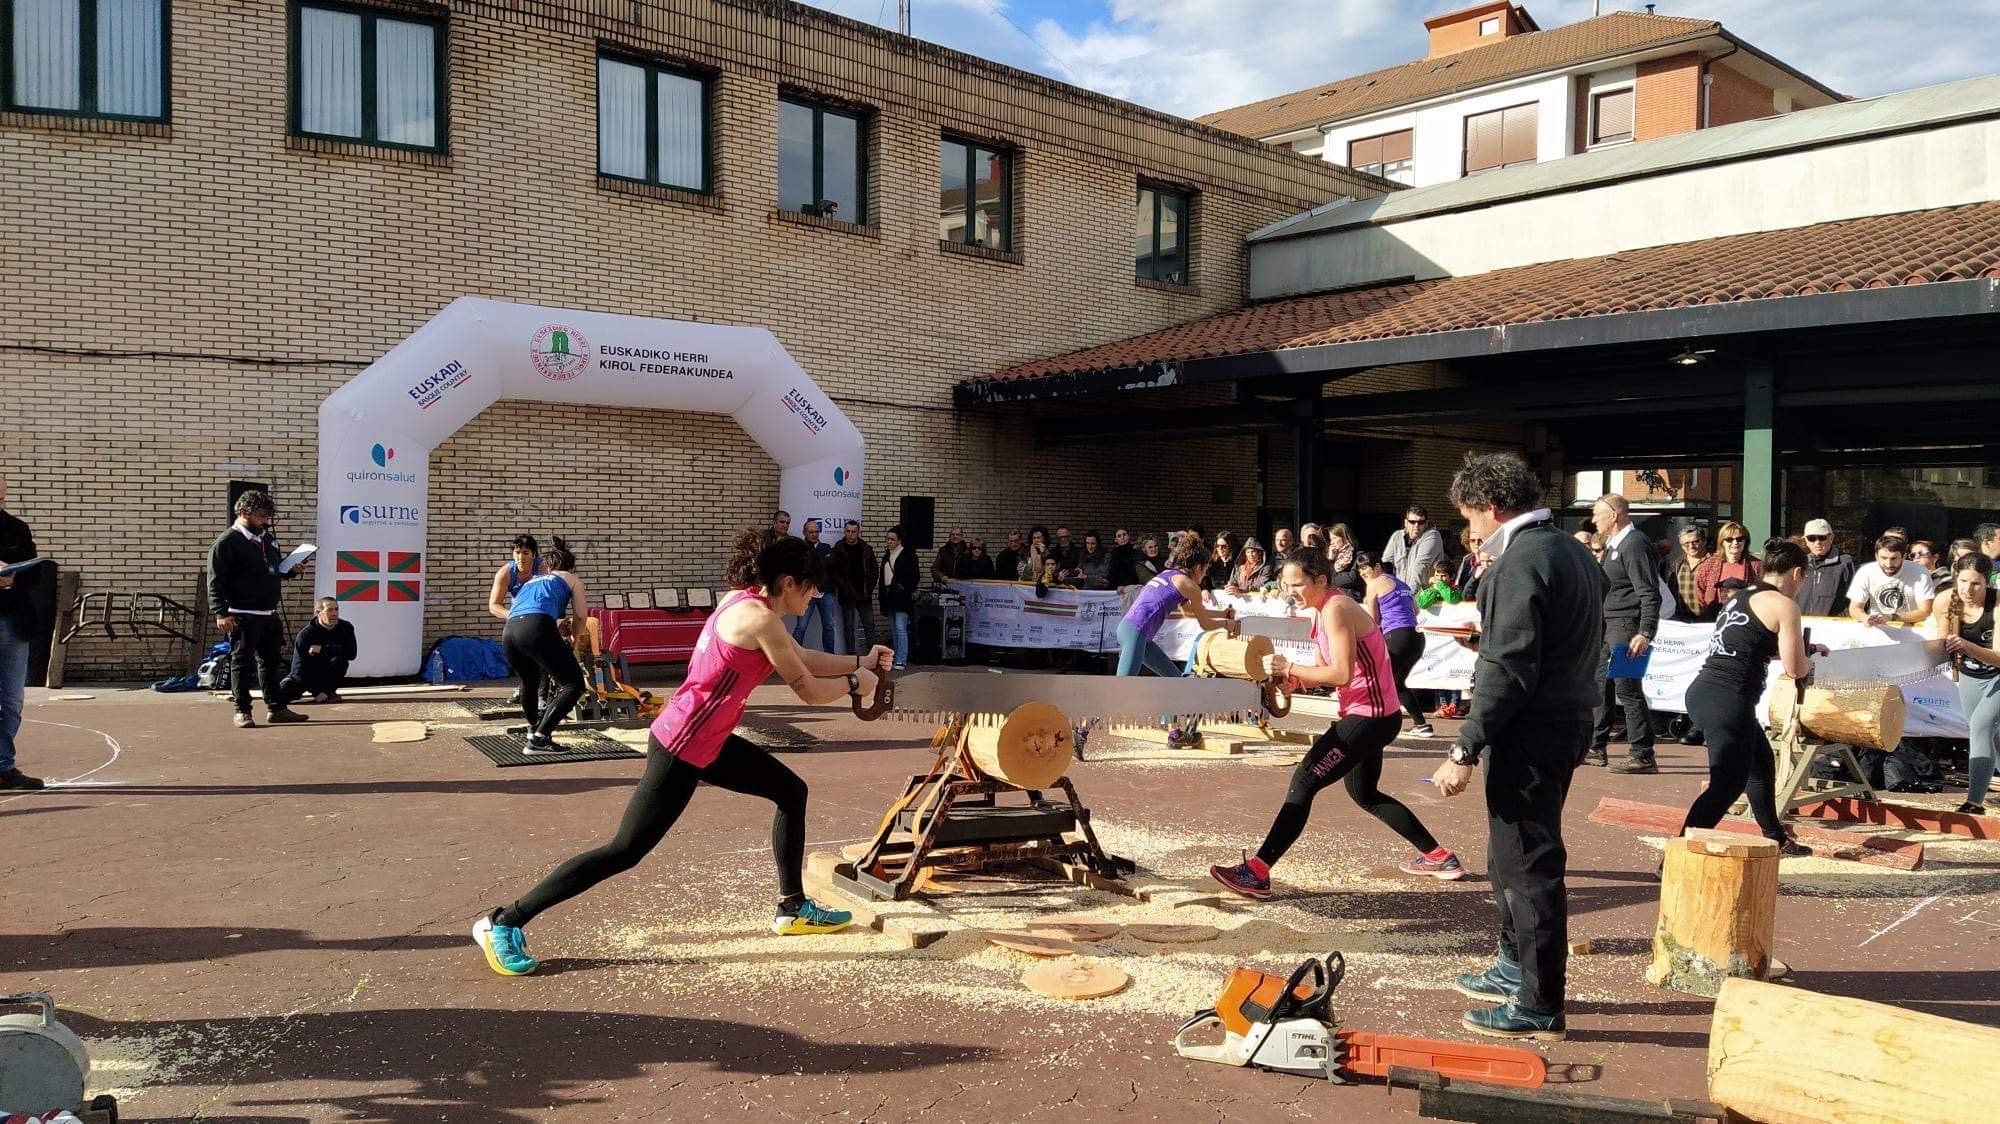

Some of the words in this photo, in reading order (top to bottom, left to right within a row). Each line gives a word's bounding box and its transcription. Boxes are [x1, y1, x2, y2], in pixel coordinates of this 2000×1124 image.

[600, 345, 671, 361] EUSKADIKO
[673, 352, 708, 363] HERRI
[408, 360, 463, 399] EUSKADI
[599, 359, 636, 372] KIROL
[639, 363, 734, 380] FEDERAKUNDEA
[418, 389, 441, 406] BASQUE
[440, 369, 468, 391] COUNTRY
[789, 388, 828, 428] EUSKADI
[800, 410, 820, 432] COUNTRY
[346, 470, 416, 483] quironsalud
[361, 505, 419, 521] surne
[1291, 1032, 1317, 1041] STIHL
